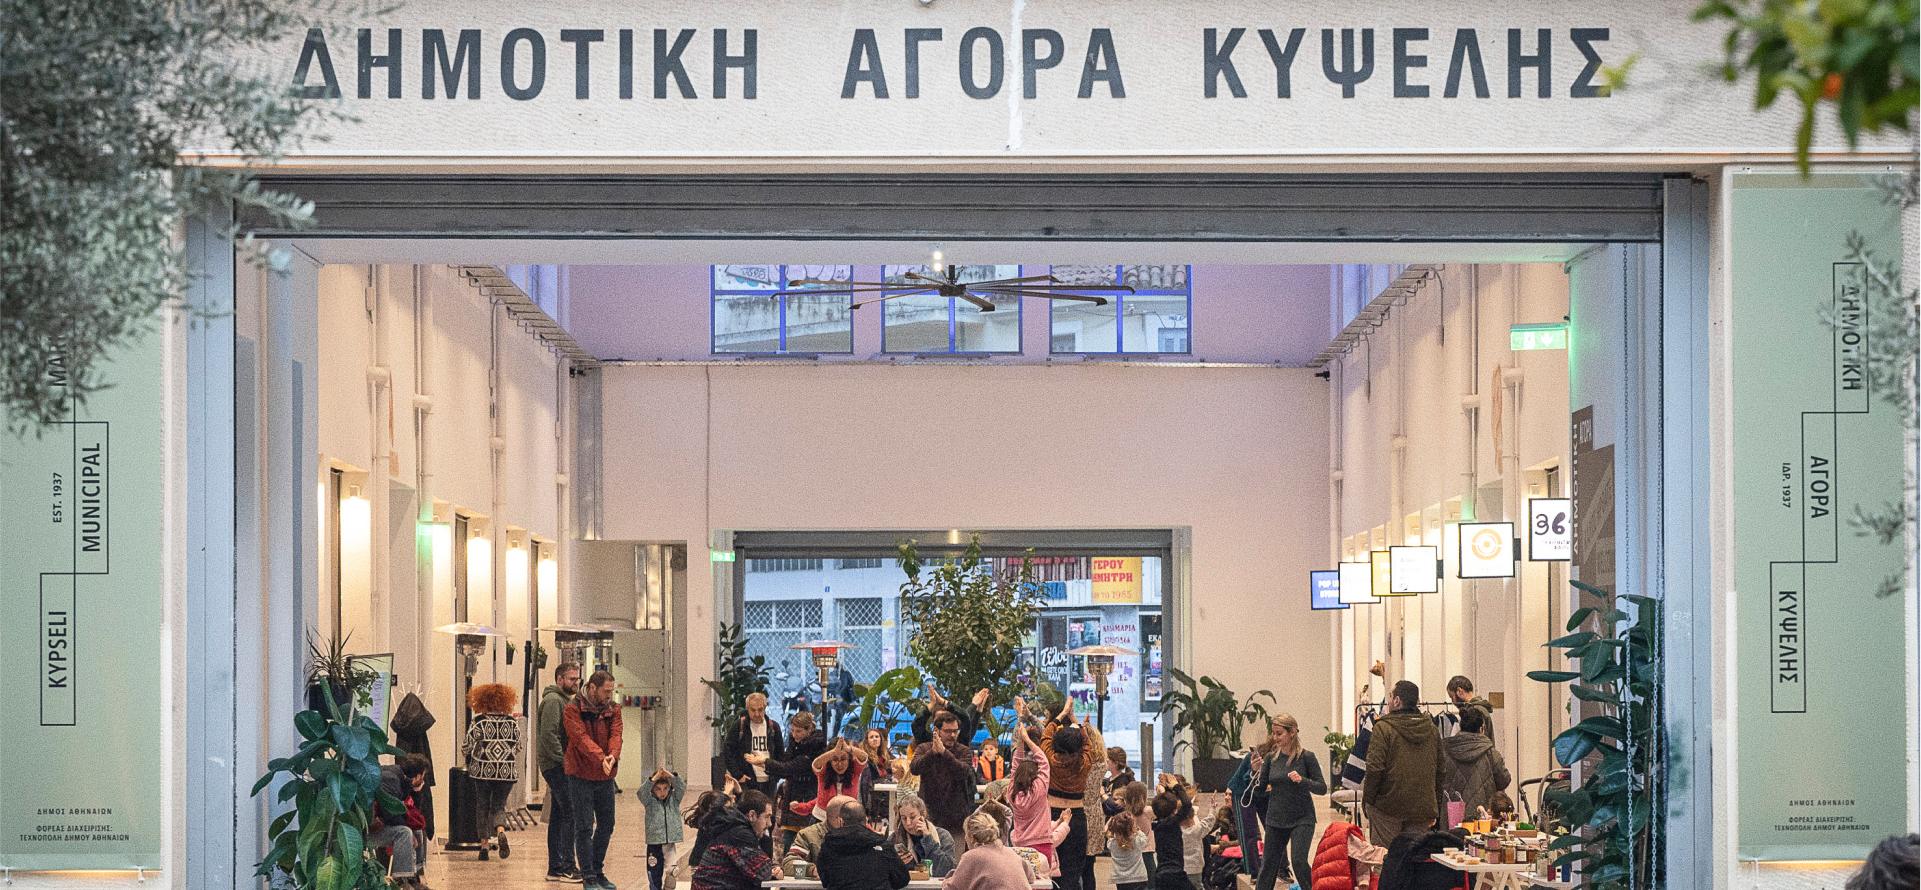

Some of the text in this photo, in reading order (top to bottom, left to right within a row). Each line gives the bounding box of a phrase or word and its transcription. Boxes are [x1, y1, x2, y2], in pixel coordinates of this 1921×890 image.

[291, 26, 1612, 100] ΔΗΜΟΤΙΚΗ ΑΓΟΡΑ ΚΥΨΕΛΗΣ
[53, 472, 62, 523] EST. 1937
[81, 443, 100, 552] MUNICIPAL
[1782, 462, 1791, 508] ΙΔΡ. 1937
[1810, 455, 1829, 519] ΑΓΟΡΑ
[48, 611, 67, 688] KYPSELI
[1778, 591, 1798, 683] ΚΥΨΕΛΗΣ
